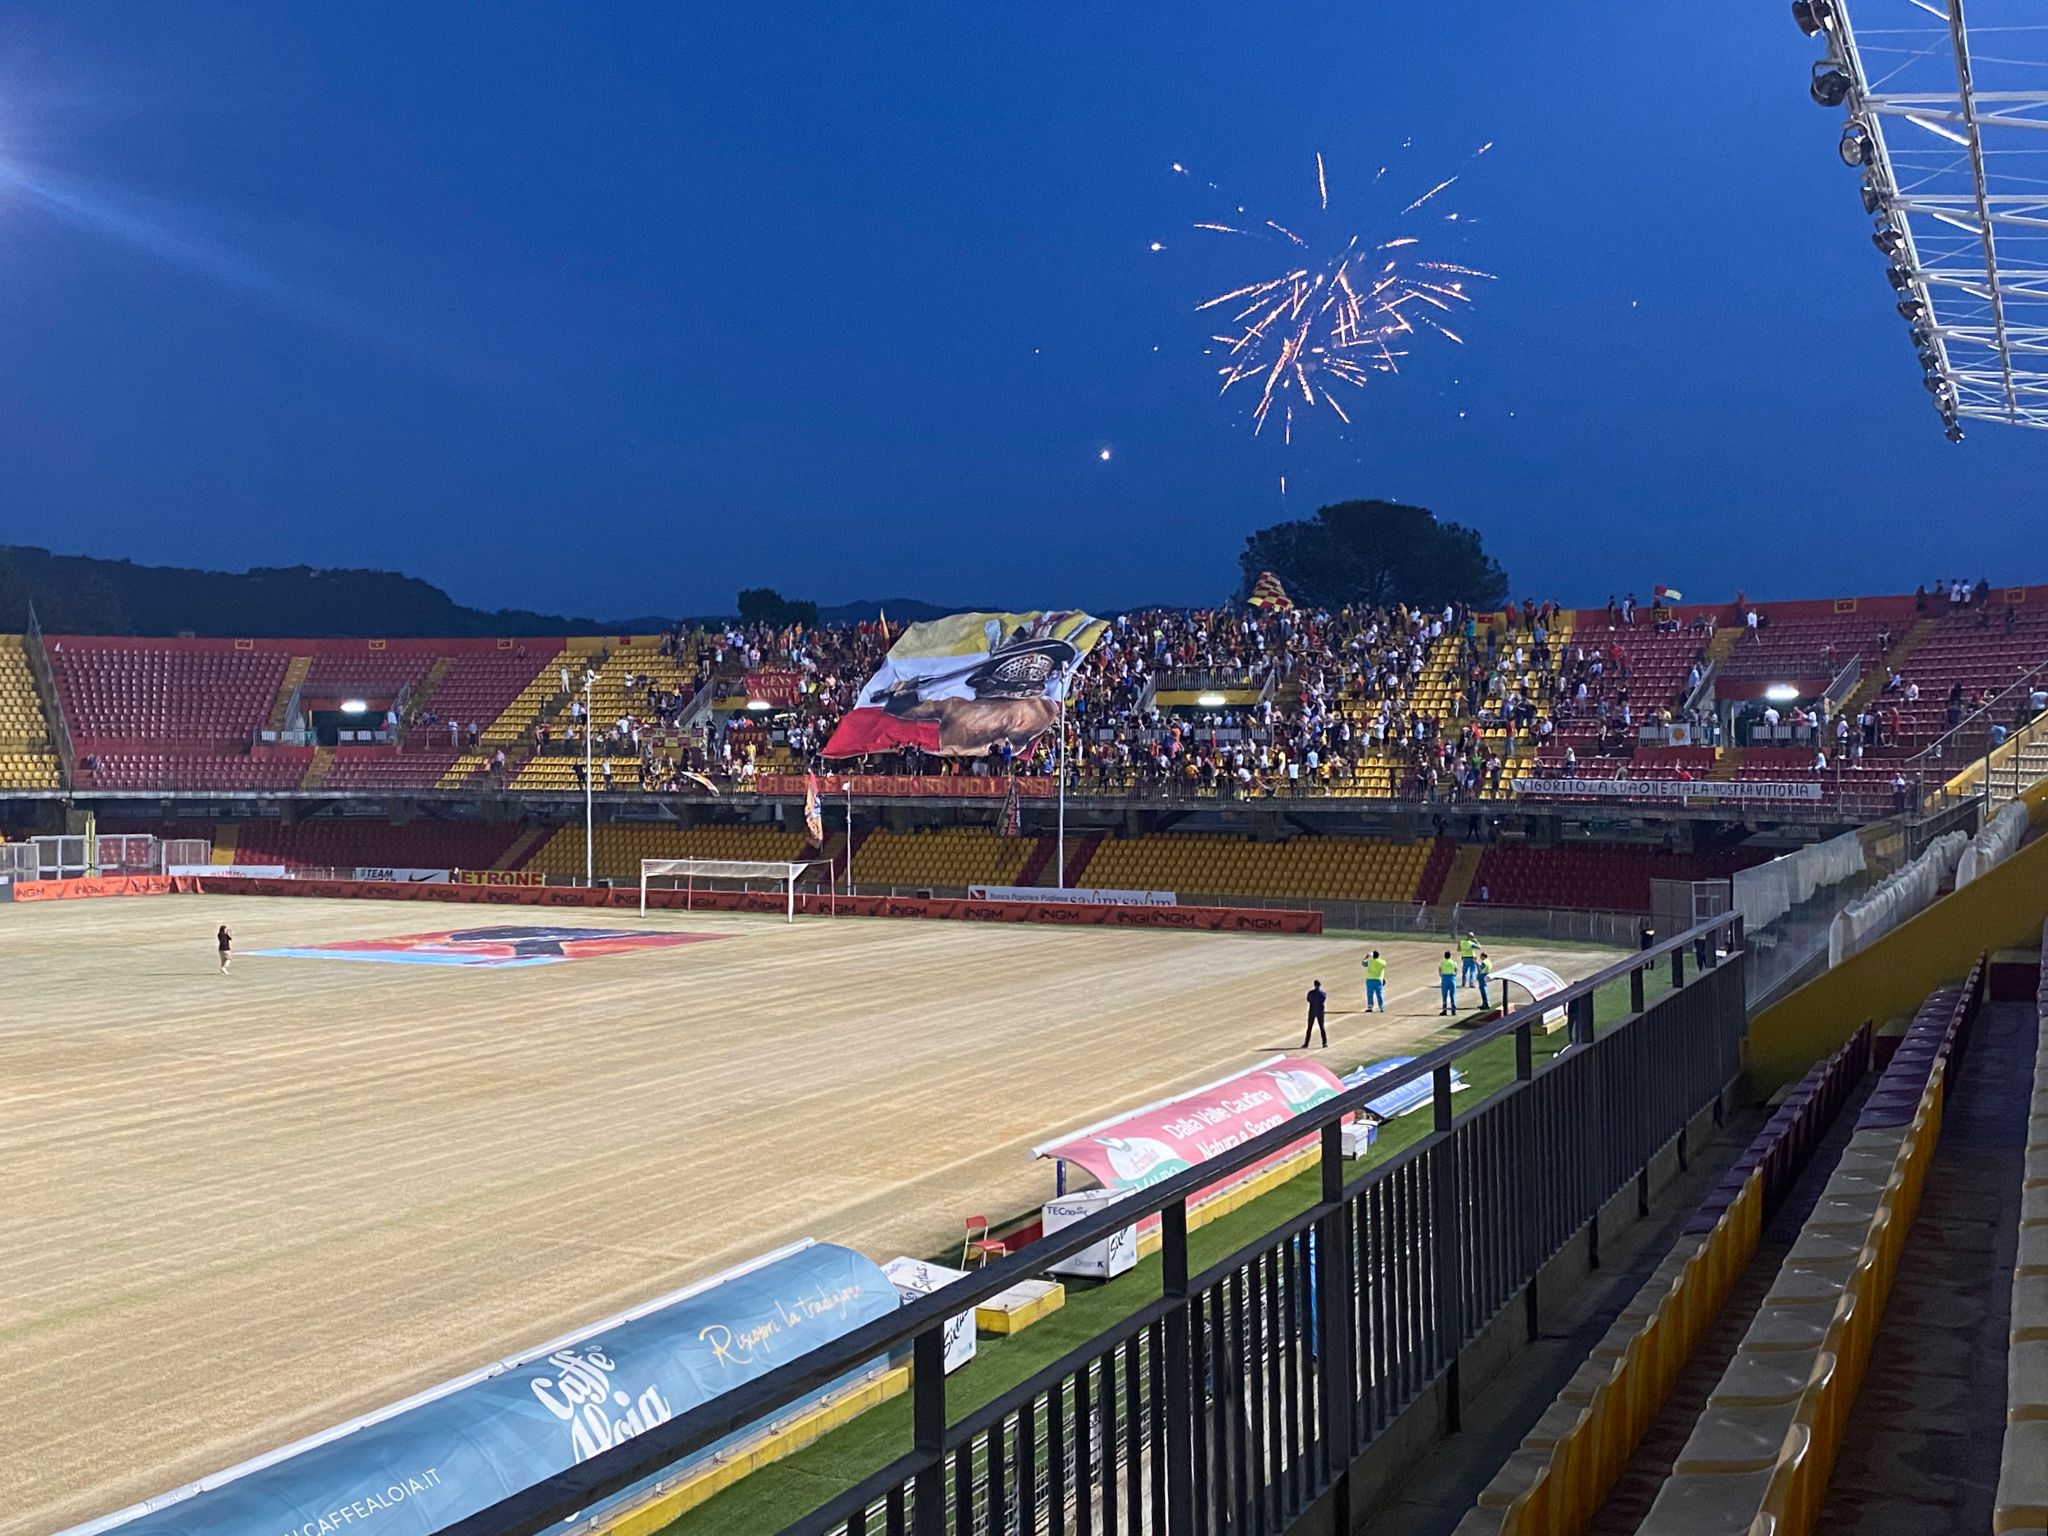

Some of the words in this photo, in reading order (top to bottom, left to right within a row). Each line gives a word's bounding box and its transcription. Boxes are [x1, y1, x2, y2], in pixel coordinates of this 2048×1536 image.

[1755, 784, 1809, 798] VITTORIA
[366, 869, 394, 878] TEAM
[1161, 1118, 1205, 1140] Dalla
[1190, 1106, 1232, 1126] Valle
[1220, 1090, 1275, 1114] Caudina
[1196, 1138, 1239, 1160] Natura
[774, 1300, 801, 1328] la
